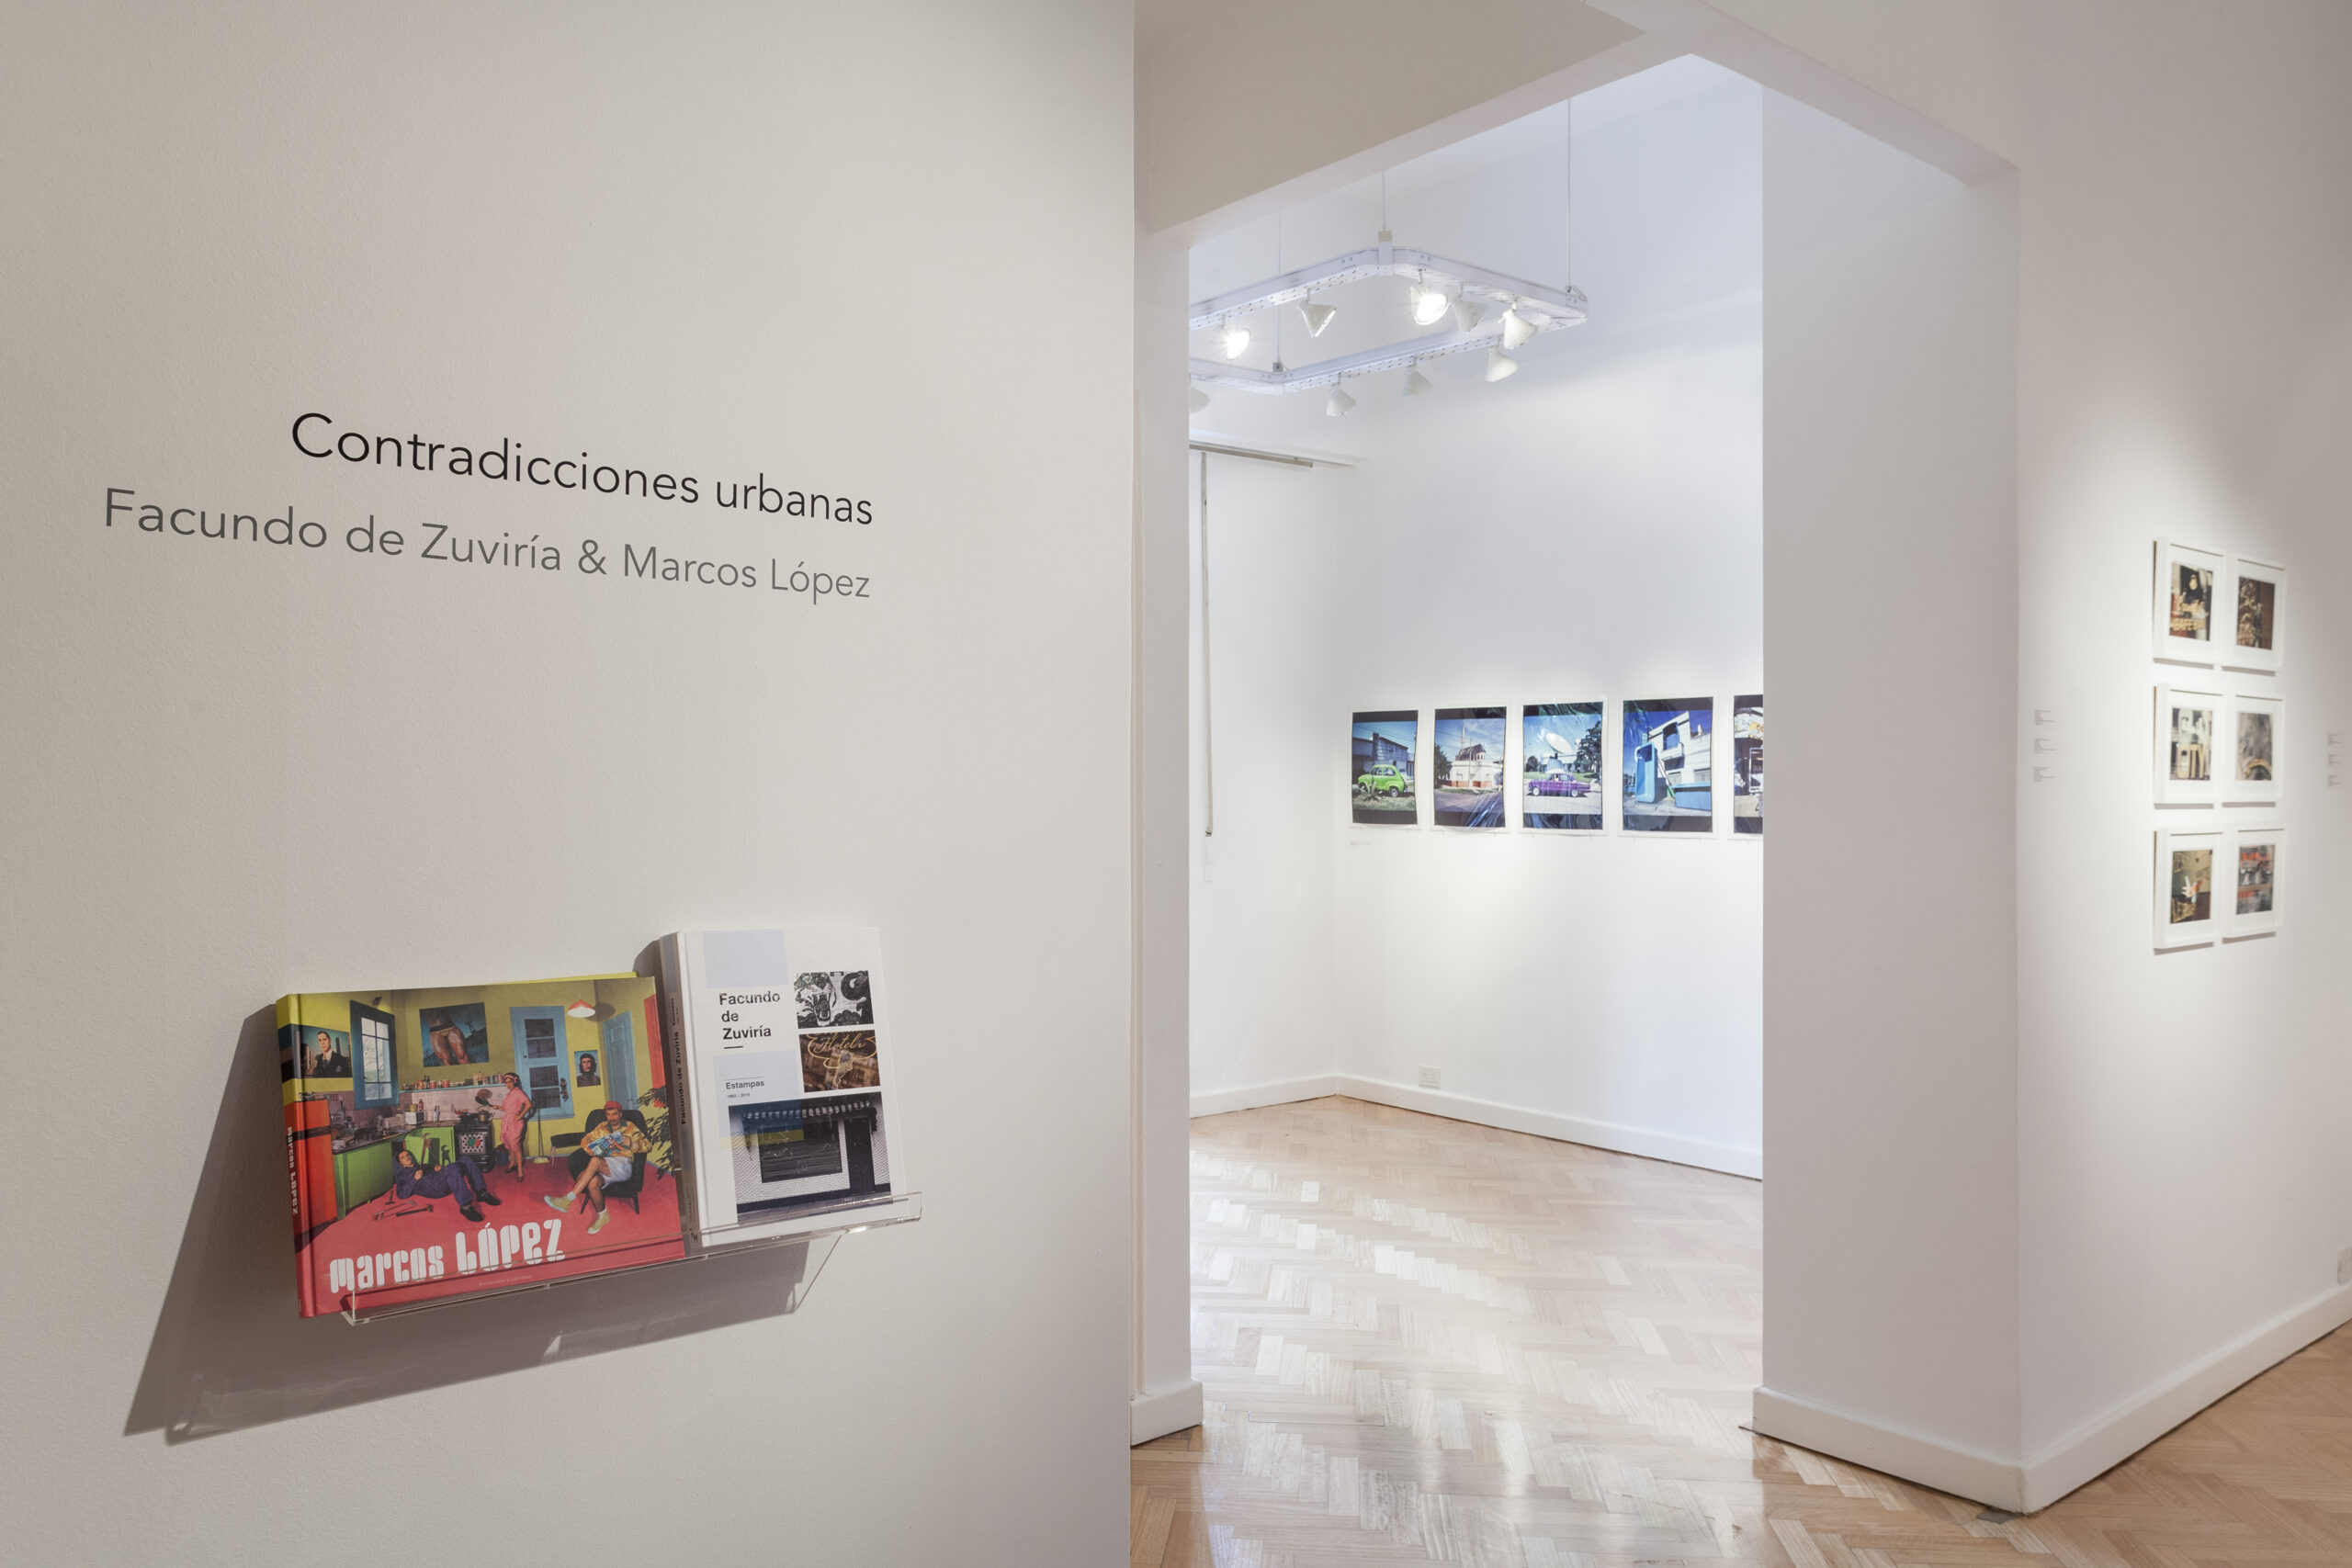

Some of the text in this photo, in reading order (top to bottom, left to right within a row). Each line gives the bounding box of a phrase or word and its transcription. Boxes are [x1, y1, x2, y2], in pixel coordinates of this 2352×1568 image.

[292, 412, 873, 525] Contradicciones urbanas
[106, 487, 870, 605] Facundo de Zuviría & Marcos López
[718, 990, 781, 1006] Facundo
[721, 1010, 740, 1022] de
[722, 1024, 772, 1040] Zuviría
[726, 1080, 765, 1089] Estampas
[678, 1082, 686, 1125] Facundo
